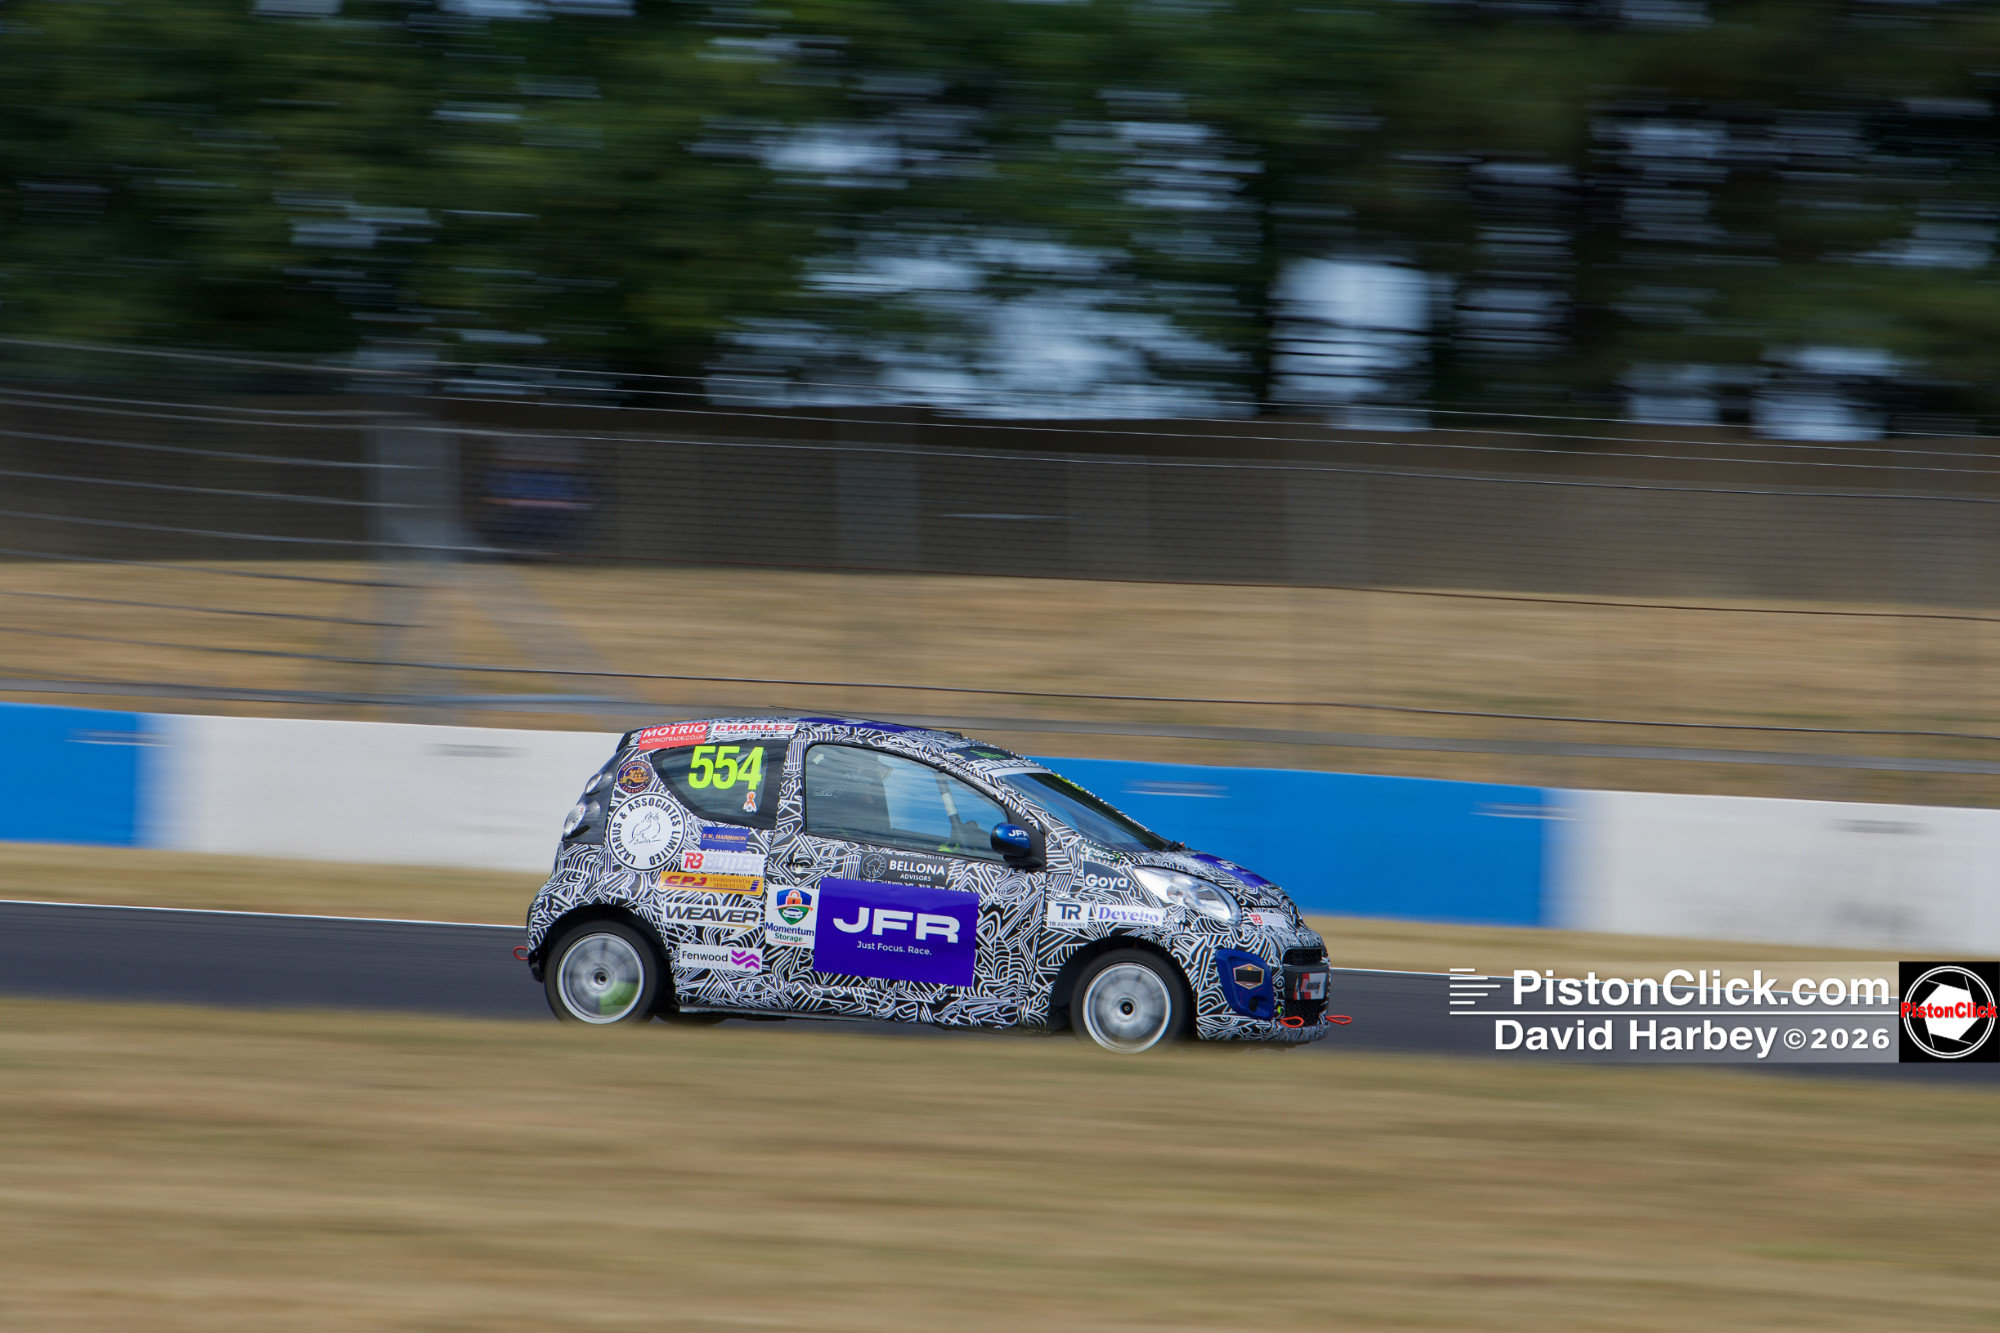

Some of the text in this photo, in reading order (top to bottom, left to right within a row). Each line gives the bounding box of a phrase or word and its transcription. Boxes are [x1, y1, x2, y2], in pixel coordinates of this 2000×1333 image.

[643, 724, 707, 738] MOTRIO
[715, 724, 796, 732] CHARLES
[641, 734, 705, 744] MOTRIOTRADE.CO.UK
[688, 745, 764, 791] 554
[610, 797, 682, 866] LAZARUS & ASSOCIATES LIMITED
[889, 859, 946, 876] BELLONA
[665, 875, 708, 887] CPJ
[900, 873, 932, 882] ADVISORS
[1085, 873, 1128, 889] Goya
[665, 905, 760, 924] WEAVER
[1056, 903, 1082, 920] TR
[765, 921, 815, 937] Momentum
[832, 906, 961, 944] JFR
[774, 933, 803, 943] Storage
[681, 950, 729, 962] Fenwood
[856, 940, 932, 956] Just Focus. Race.
